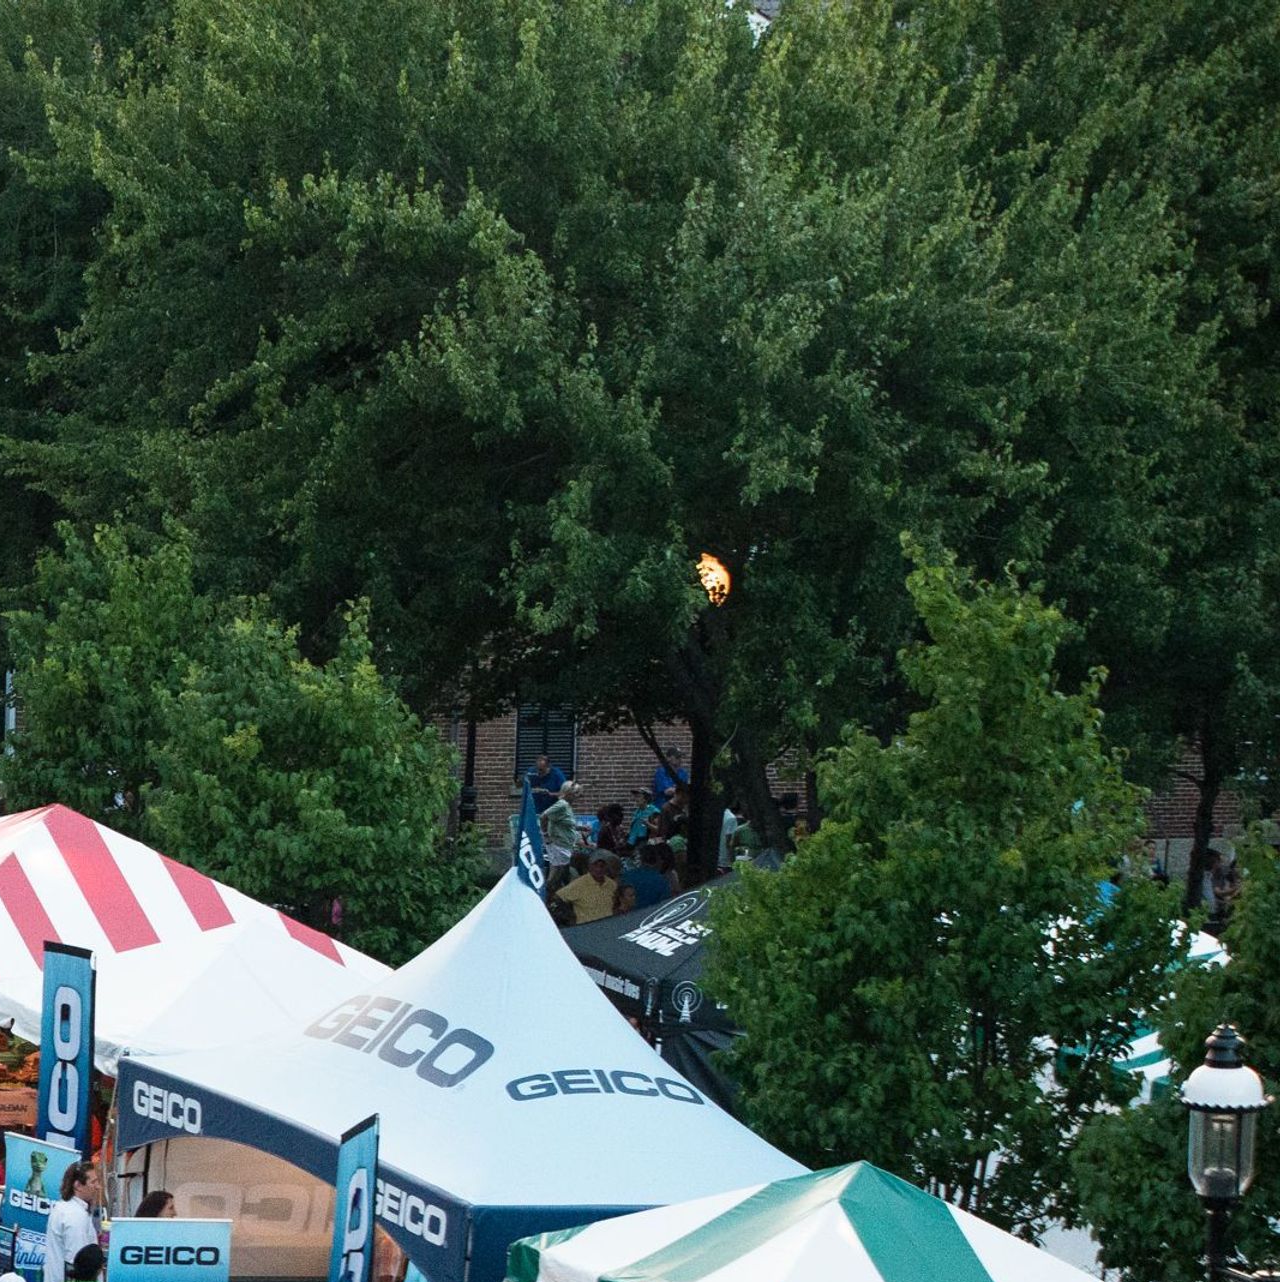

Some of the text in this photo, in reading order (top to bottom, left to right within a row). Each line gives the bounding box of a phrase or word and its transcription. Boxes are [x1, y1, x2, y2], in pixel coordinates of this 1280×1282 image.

[519, 831, 545, 889] ICO
[46, 986, 81, 1149] ICO
[303, 994, 496, 1088] GEICO
[132, 1080, 202, 1134] GEICO
[505, 1069, 705, 1105] GEICO
[9, 1188, 55, 1215] GEIC
[120, 1246, 220, 1265] GEICO
